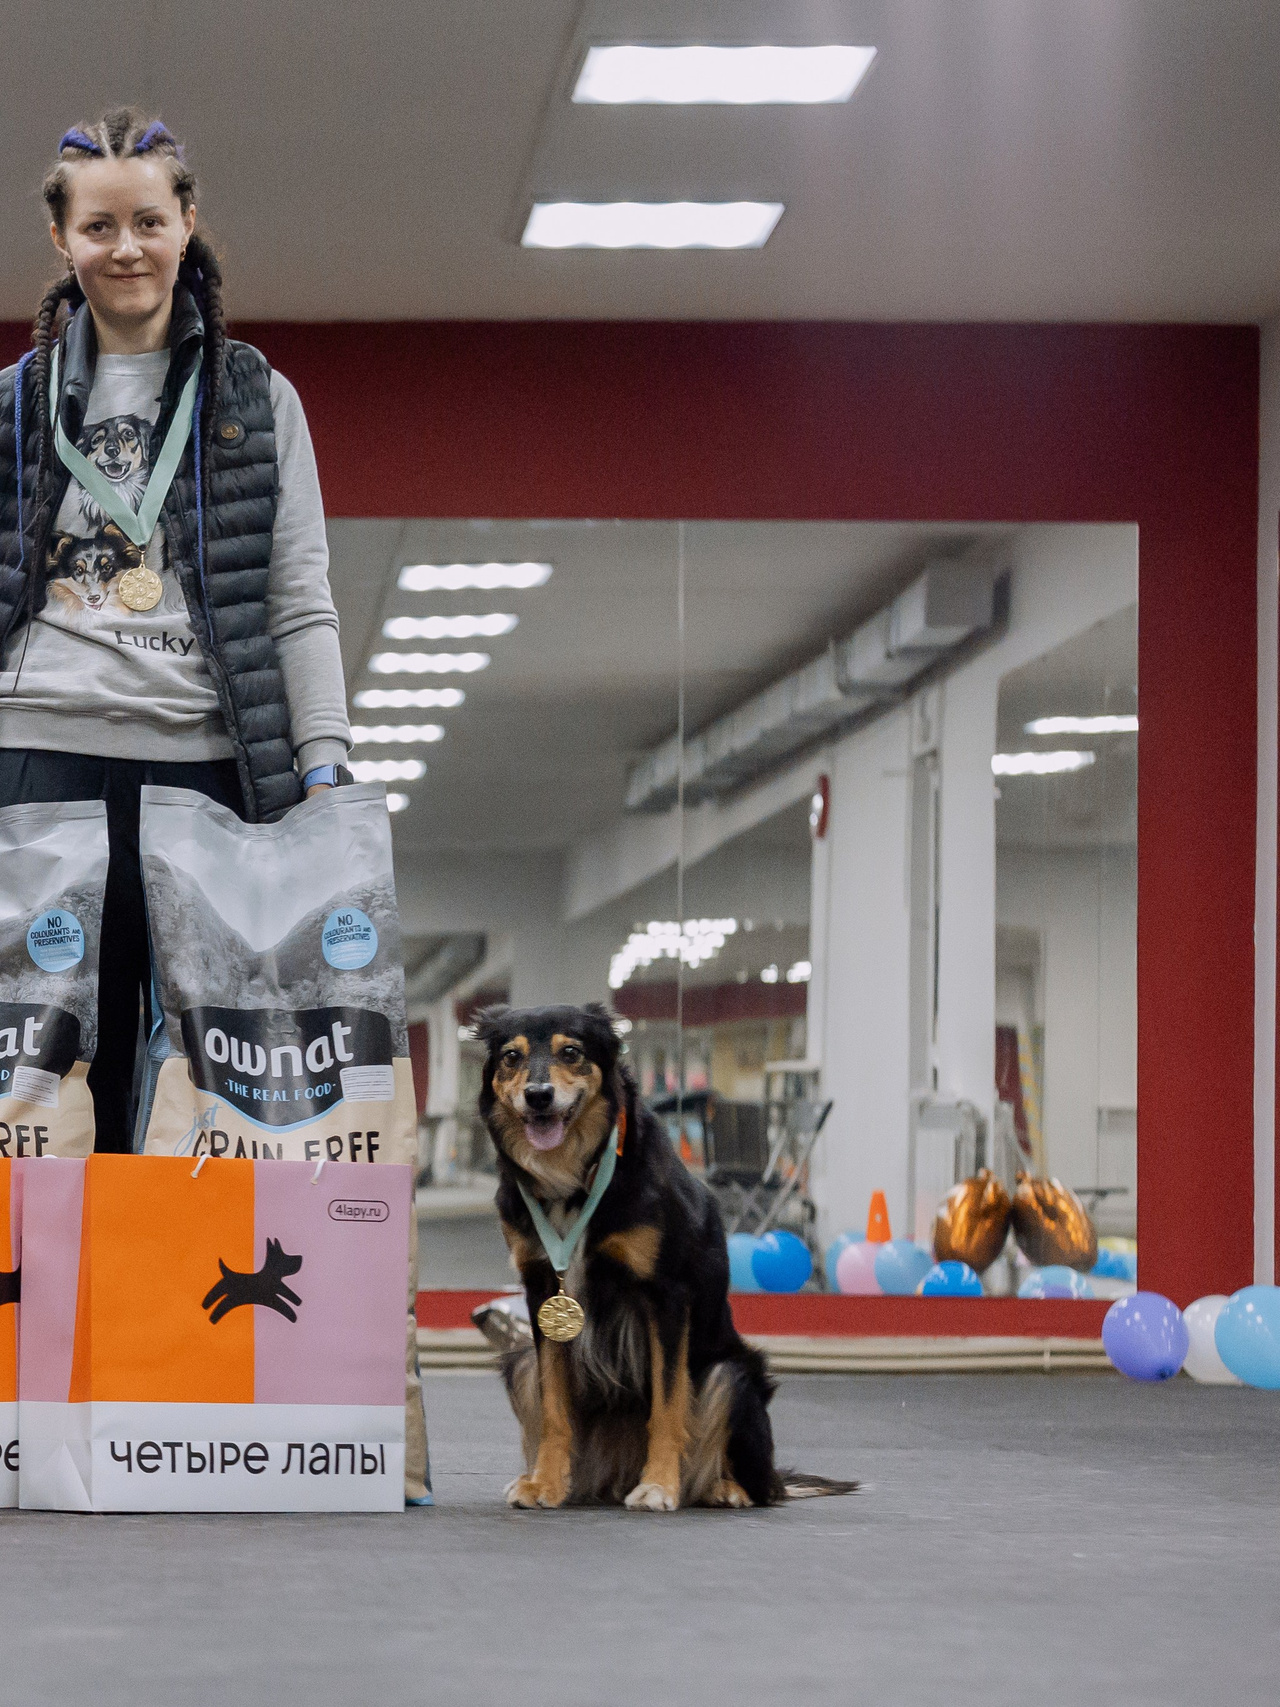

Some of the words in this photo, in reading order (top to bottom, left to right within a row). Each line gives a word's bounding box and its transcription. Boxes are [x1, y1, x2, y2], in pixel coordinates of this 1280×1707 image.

[115, 630, 195, 656] Lucky
[48, 916, 62, 929] NO
[338, 914, 353, 926] NO
[31, 927, 70, 939] COLOURANTS
[34, 935, 80, 947] PRESERVATIVES
[205, 1021, 354, 1077] ownat
[227, 1079, 249, 1098] THE
[253, 1088, 290, 1102] REAL
[294, 1082, 332, 1101] FOOD
[173, 1102, 223, 1157] just
[335, 1204, 381, 1219] 4lapy.ru
[110, 1441, 269, 1474] четыре
[281, 1442, 385, 1475] лапы
